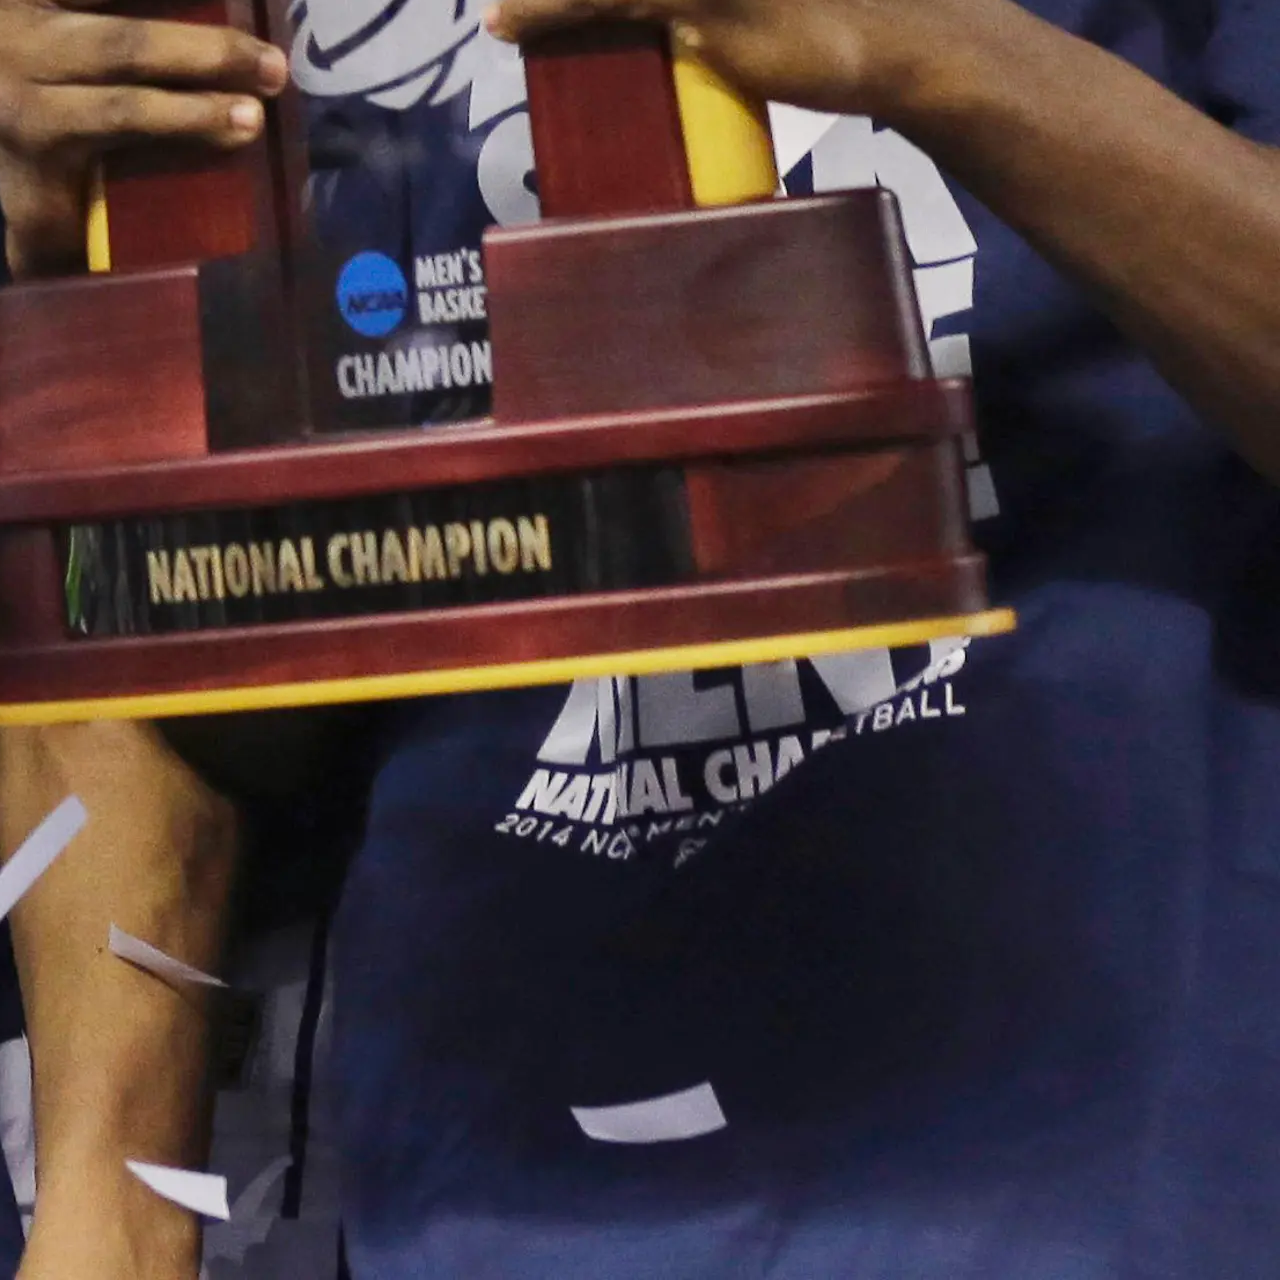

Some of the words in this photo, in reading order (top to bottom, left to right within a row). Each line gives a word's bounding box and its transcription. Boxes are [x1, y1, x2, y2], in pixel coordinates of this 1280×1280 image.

[414, 246, 484, 290] MEN'S
[146, 532, 324, 605] NATIONAL
[327, 515, 552, 588] CHAMPION
[494, 813, 574, 848] 2014
